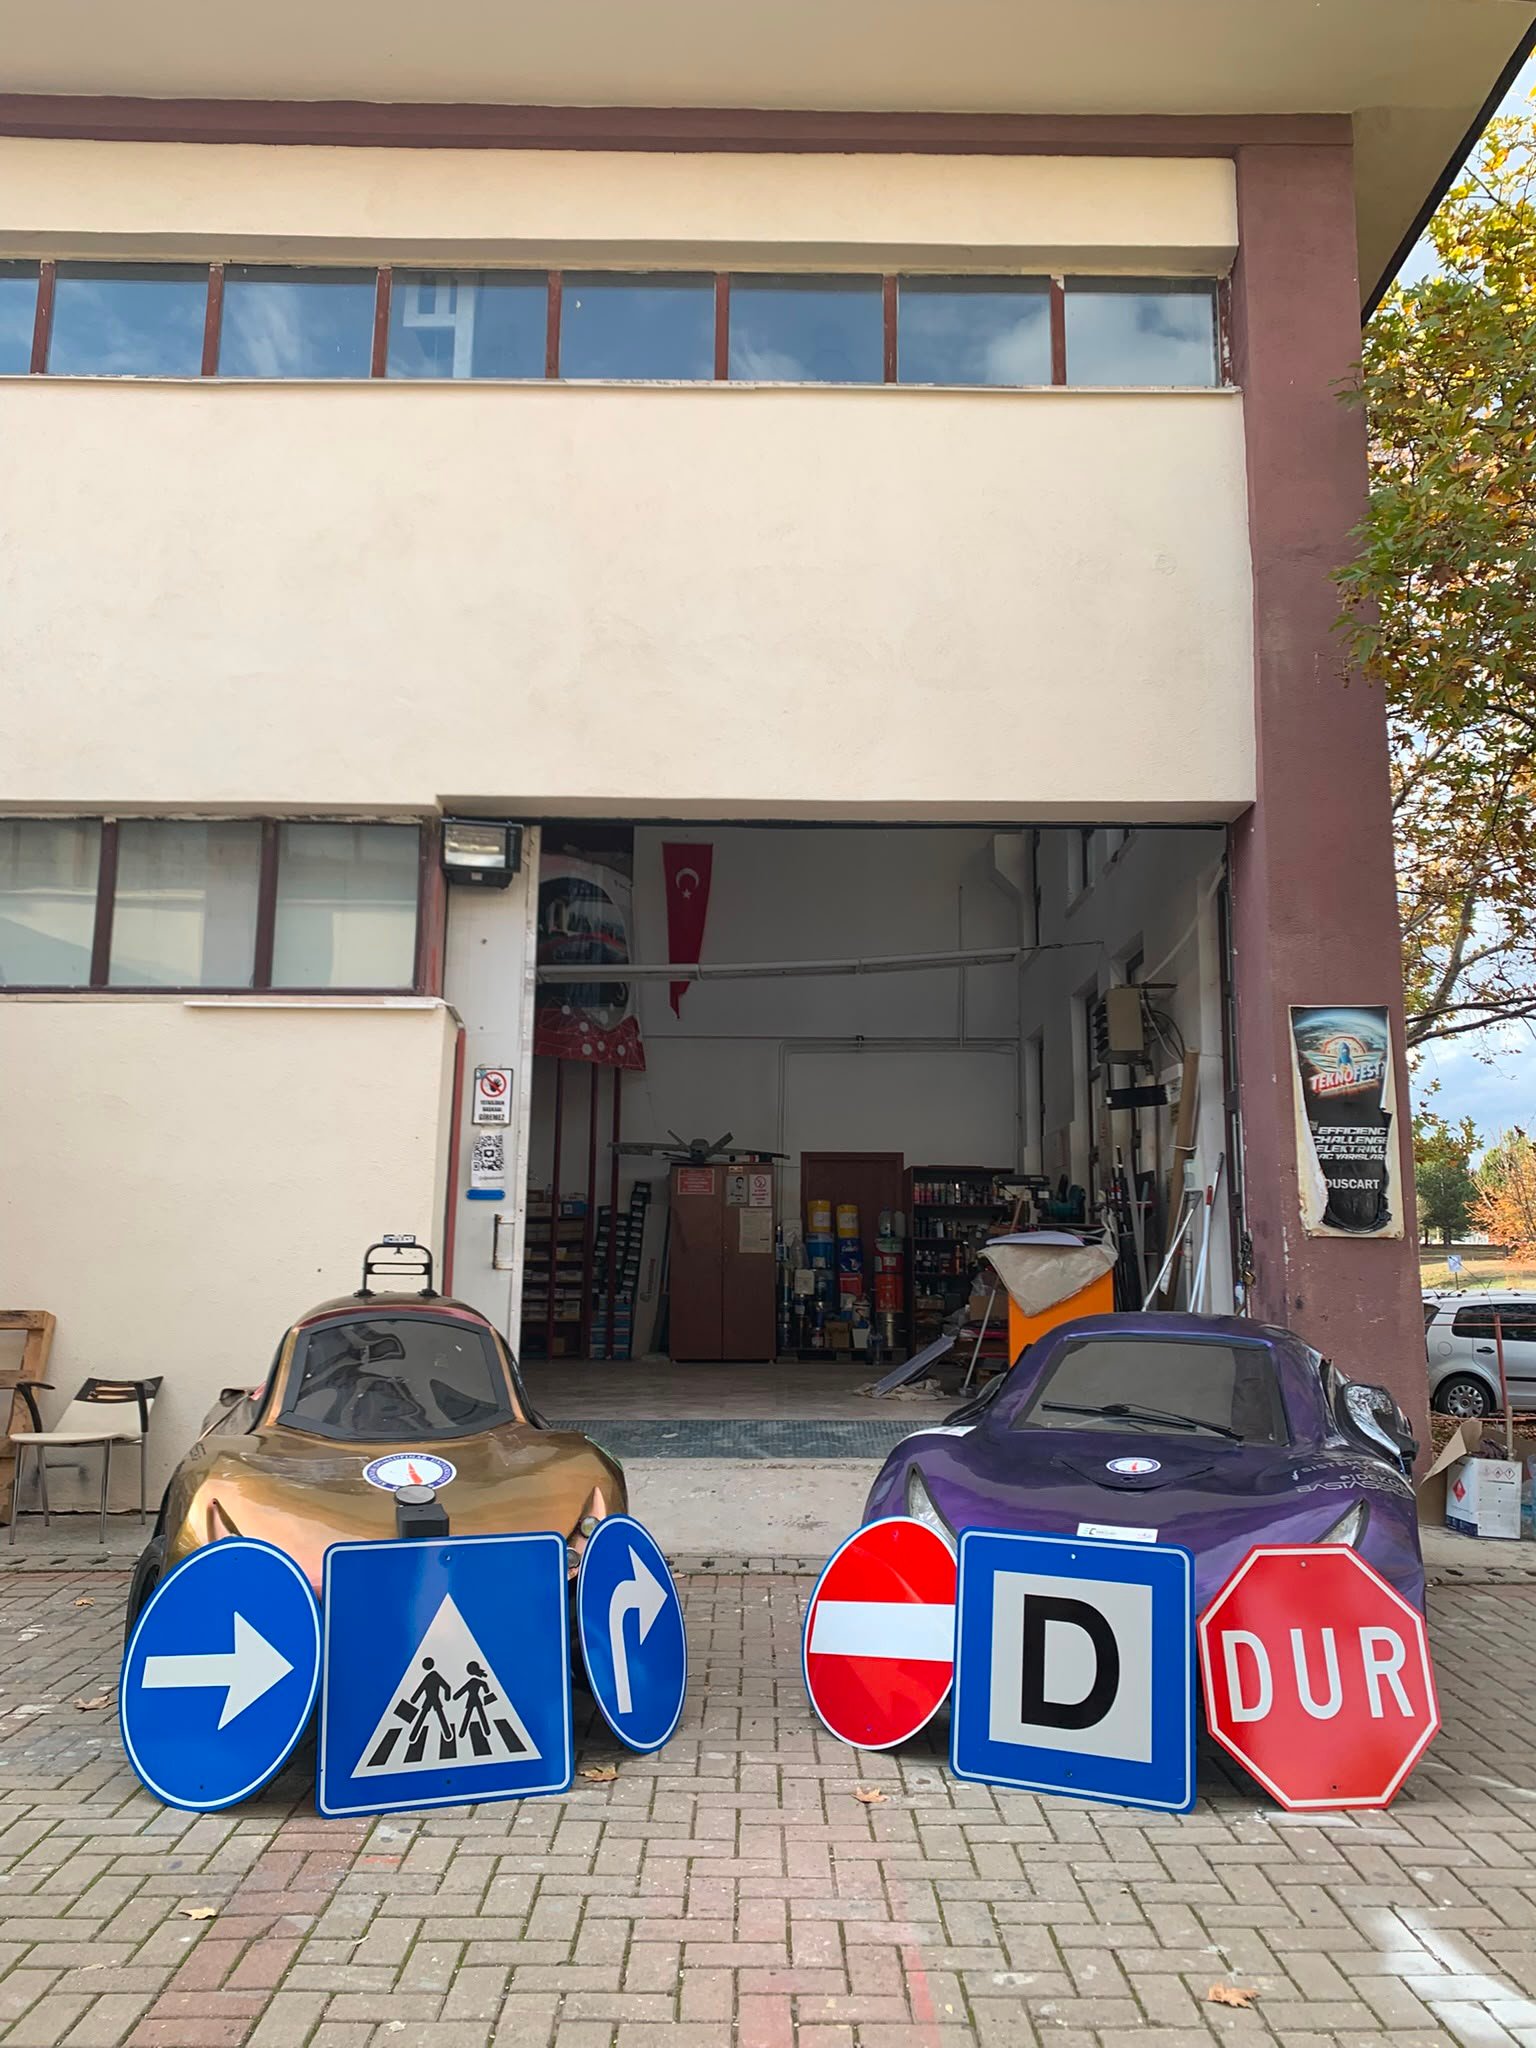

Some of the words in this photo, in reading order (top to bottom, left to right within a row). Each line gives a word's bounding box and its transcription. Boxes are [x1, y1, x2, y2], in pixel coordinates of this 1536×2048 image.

[1311, 1061, 1385, 1094] TEKNOFEST
[1021, 1593, 1120, 1730] D
[1221, 1626, 1415, 1722] DUR
